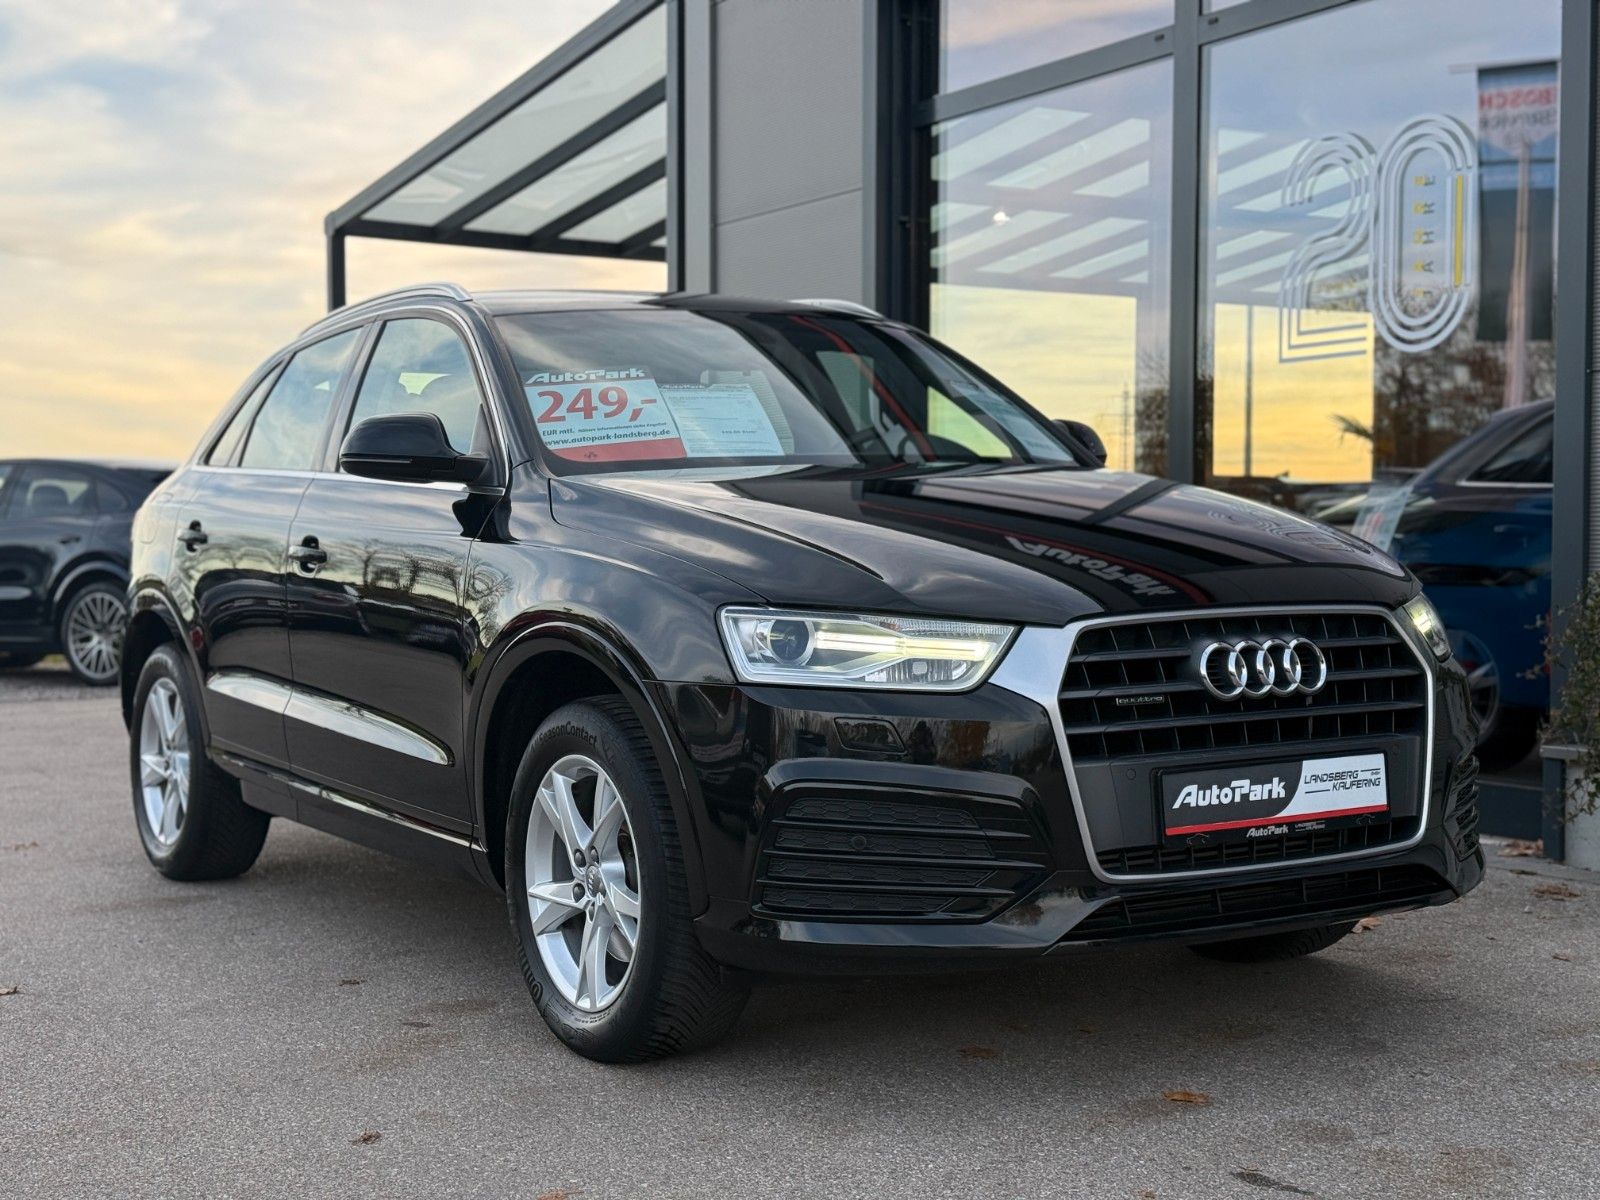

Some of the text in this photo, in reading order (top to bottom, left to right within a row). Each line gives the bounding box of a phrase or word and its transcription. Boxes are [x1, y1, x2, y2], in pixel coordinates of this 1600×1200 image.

[525, 368, 645, 384] AutoPark
[537, 386, 657, 424] 249,-
[1304, 770, 1358, 784] LANDSBERG
[1332, 778, 1381, 791] KAUFERING
[1172, 777, 1286, 809] AutoPark
[1246, 824, 1288, 838] AutoPark
